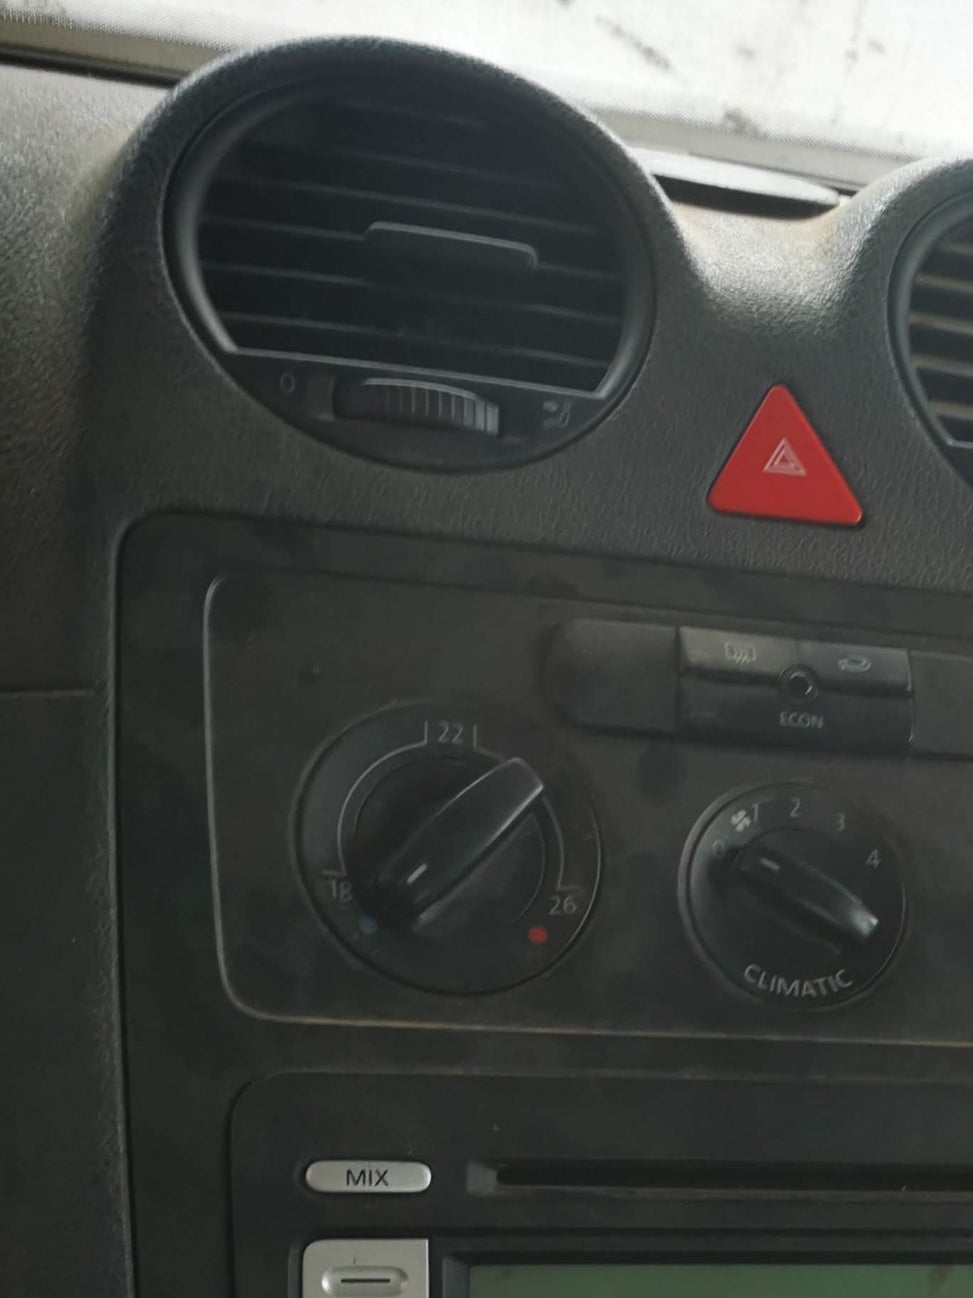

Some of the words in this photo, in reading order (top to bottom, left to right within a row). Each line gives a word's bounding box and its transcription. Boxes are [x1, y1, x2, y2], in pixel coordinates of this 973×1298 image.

[779, 711, 824, 729] ECON
[437, 720, 464, 745] 22
[790, 798, 801, 818] 2
[835, 813, 846, 832] 3
[866, 850, 880, 869] 4
[550, 895, 577, 916] 26
[744, 964, 852, 998] CLIMATIC
[346, 1169, 389, 1187] MIX
